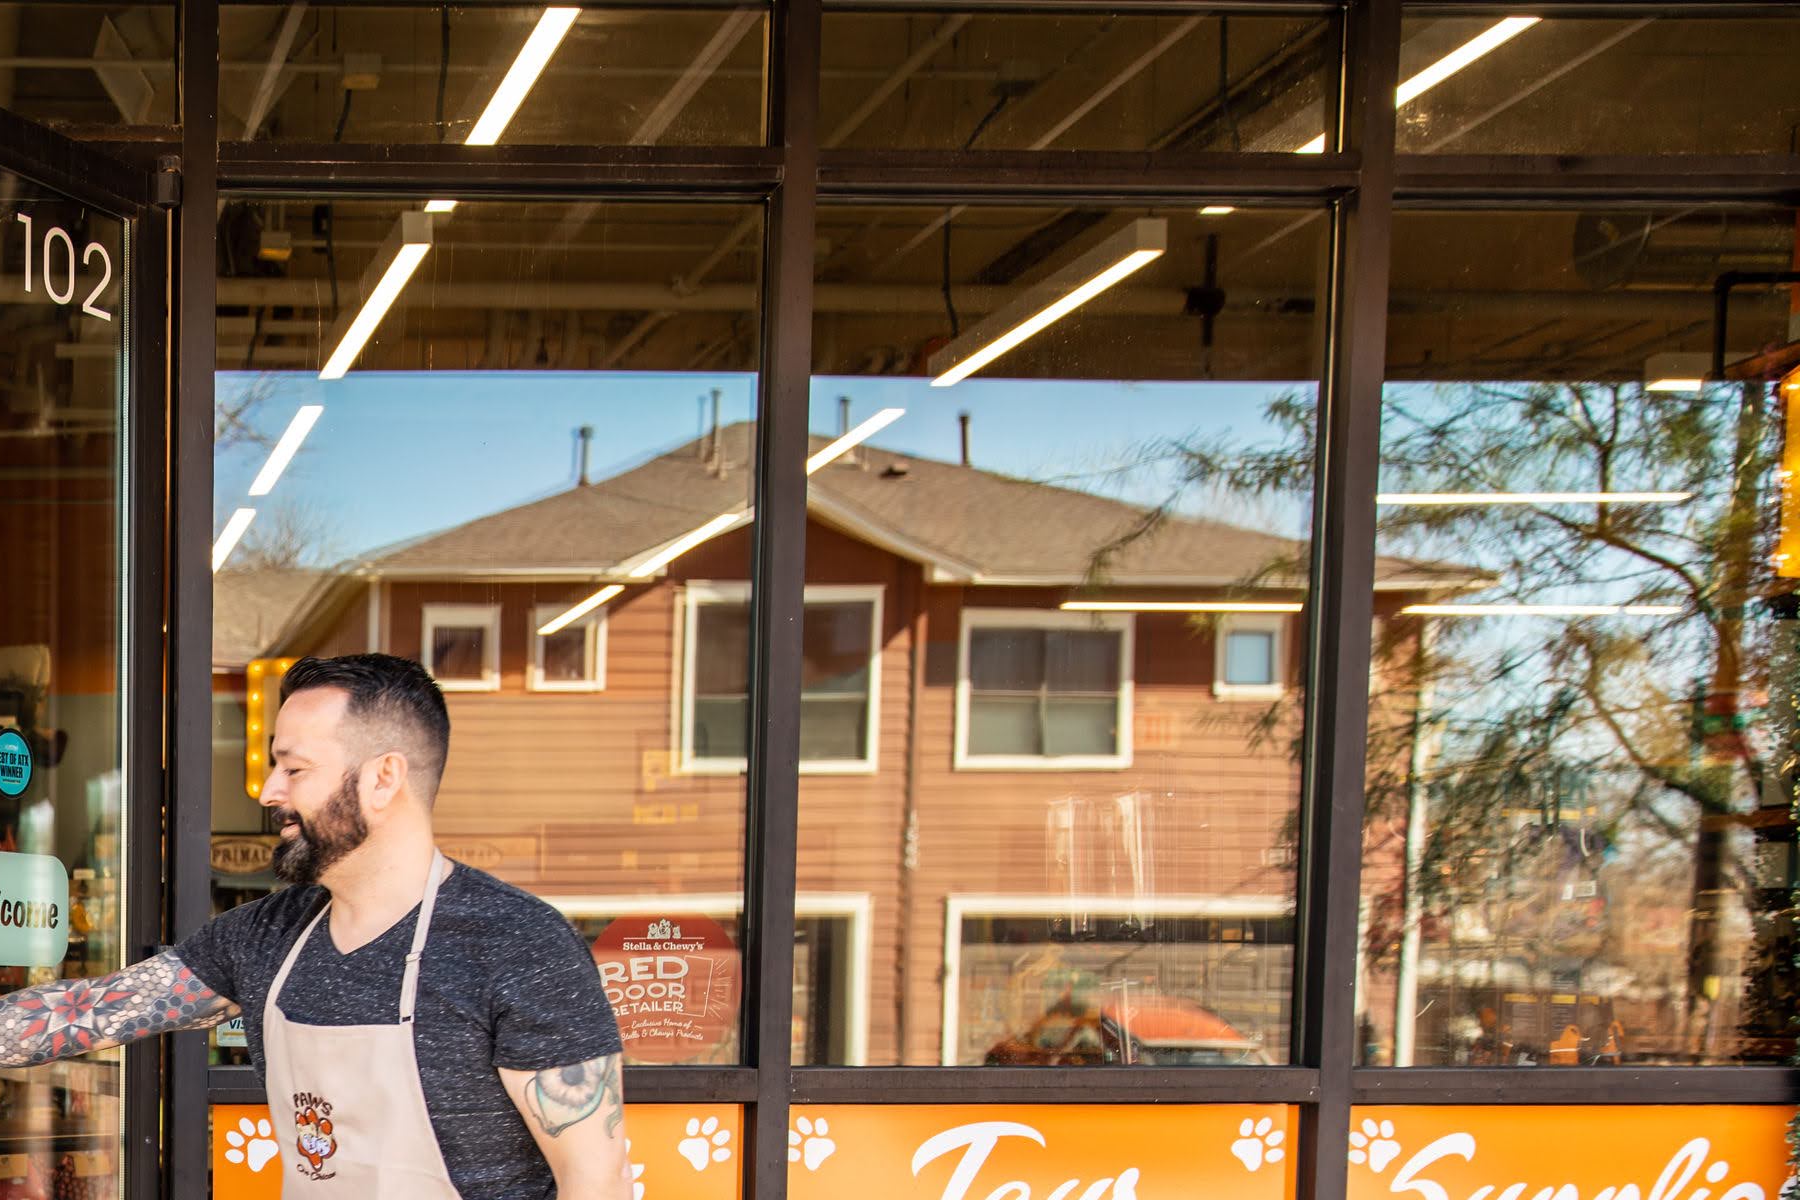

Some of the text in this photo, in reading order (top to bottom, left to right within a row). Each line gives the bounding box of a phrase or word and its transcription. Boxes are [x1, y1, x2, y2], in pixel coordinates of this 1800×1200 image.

[17, 213, 112, 322] 102
[10, 753, 17, 765] OF
[18, 754, 29, 767] ATX
[1, 765, 23, 778] WINNER
[212, 846, 271, 864] PRIMAL
[623, 941, 704, 952] Stella & Chewy's
[597, 956, 690, 988] RED
[604, 982, 687, 1005] DOOR
[230, 1019, 246, 1029] VI
[663, 1018, 682, 1027] Home
[683, 1020, 693, 1030] of
[641, 1029, 648, 1038] &
[675, 1029, 704, 1041] Products
[293, 1092, 333, 1116] PAWS
